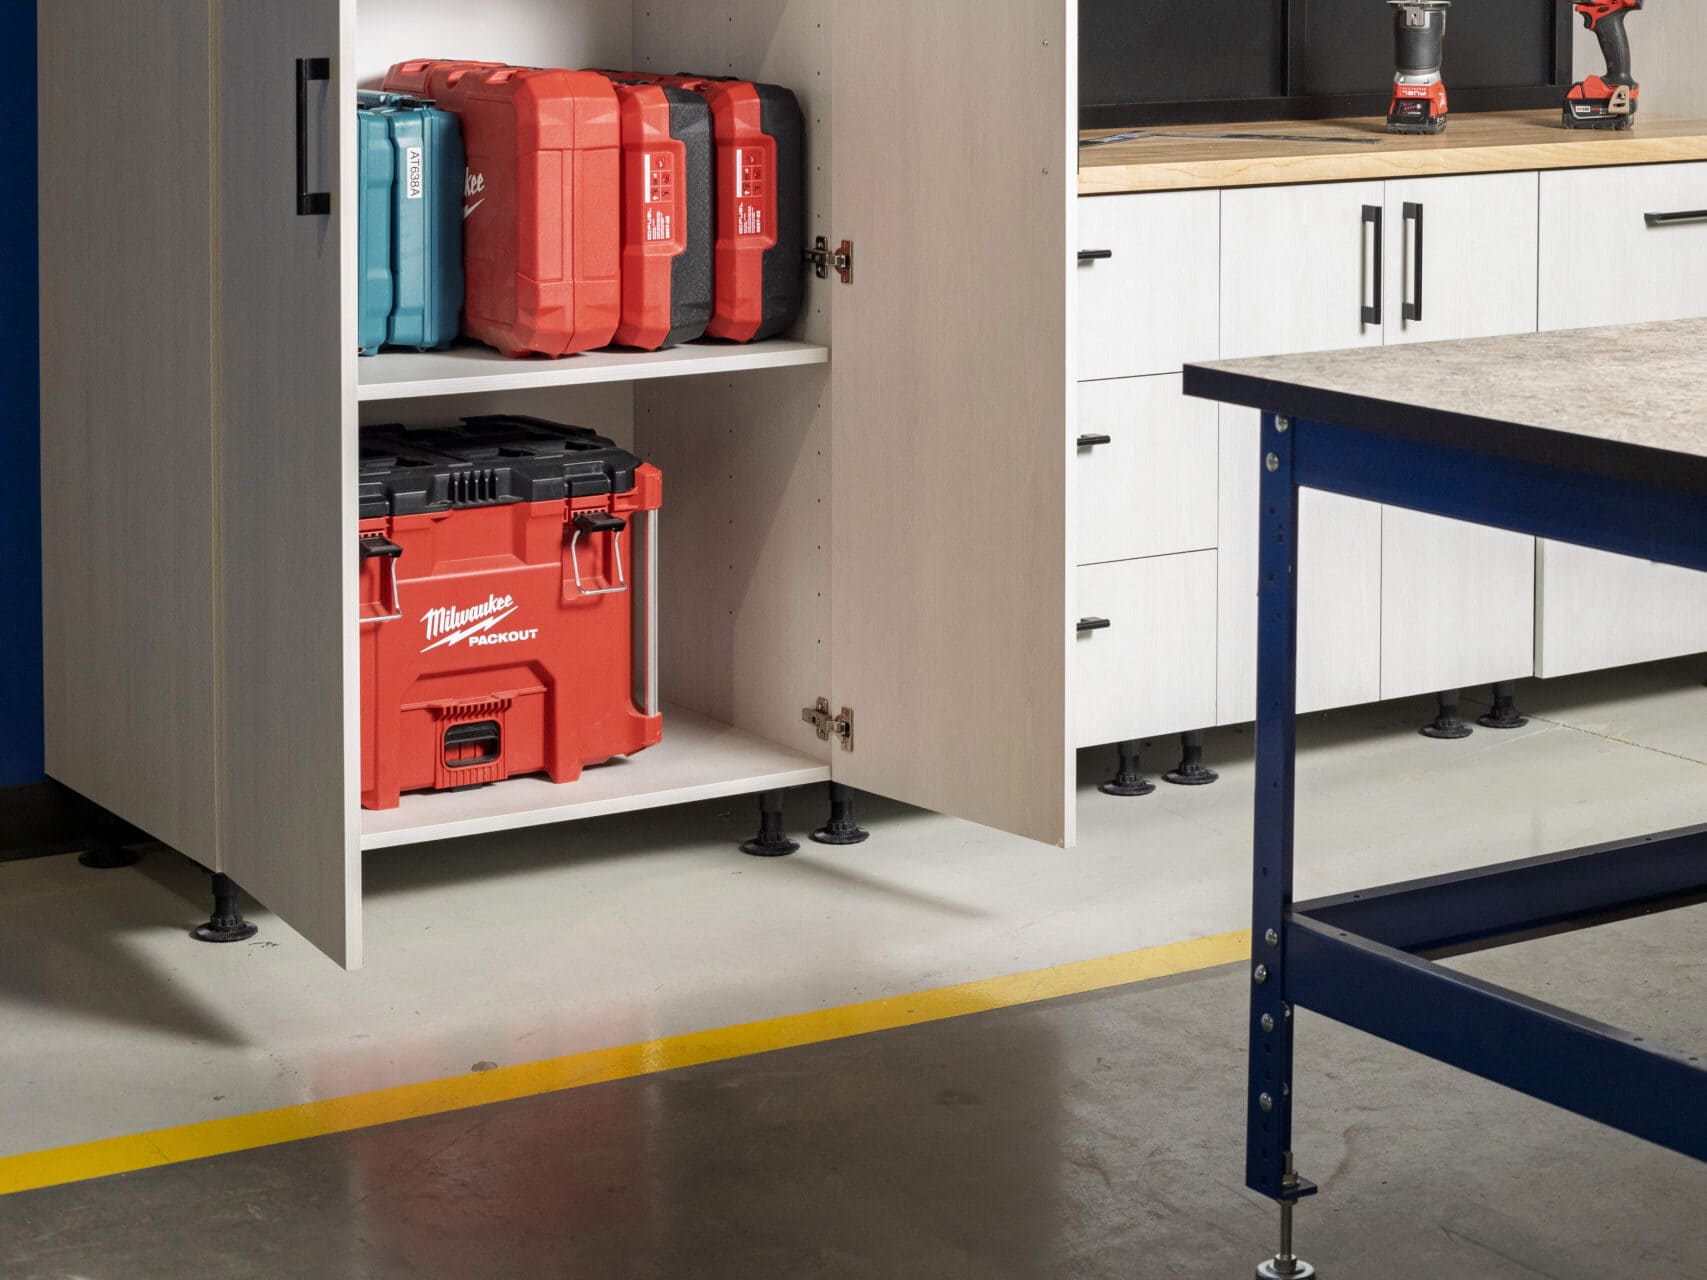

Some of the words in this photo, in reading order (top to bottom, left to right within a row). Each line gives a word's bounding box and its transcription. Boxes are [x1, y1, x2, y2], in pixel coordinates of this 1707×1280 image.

[410, 151, 420, 197] AT638A
[464, 167, 485, 197] kee
[420, 594, 514, 641] Milwaukee
[468, 628, 538, 647] PACKOUT
